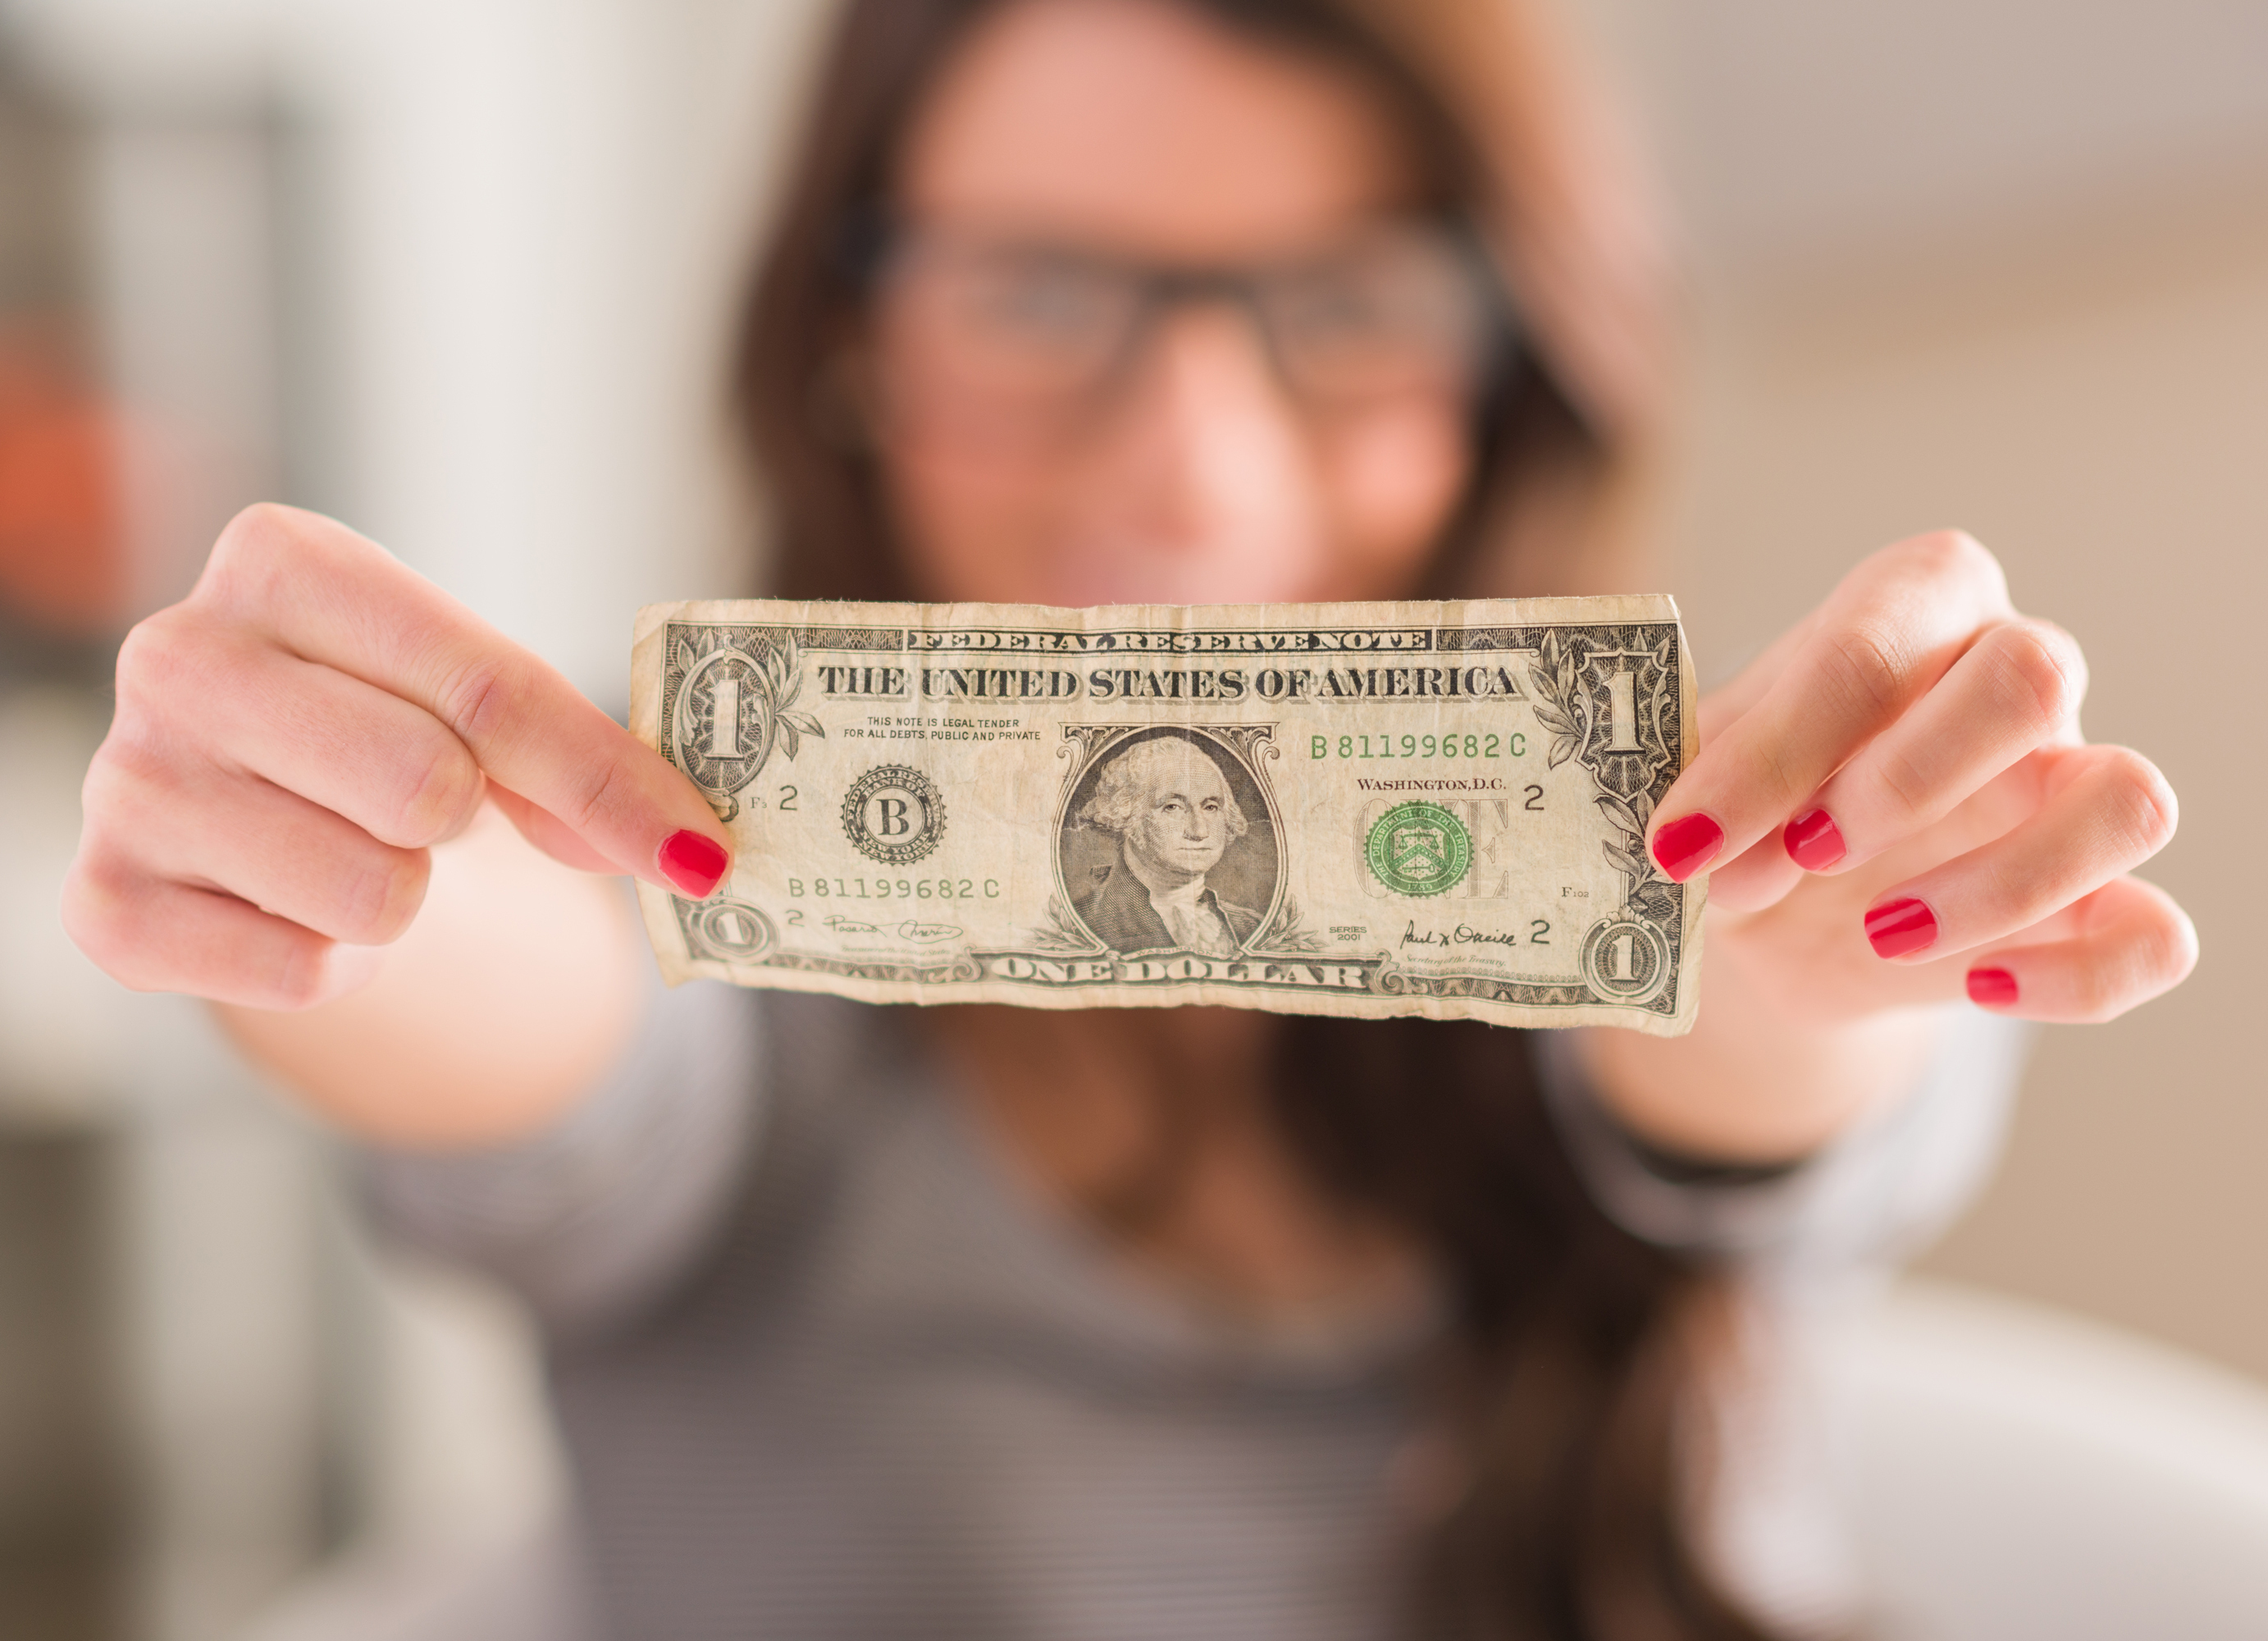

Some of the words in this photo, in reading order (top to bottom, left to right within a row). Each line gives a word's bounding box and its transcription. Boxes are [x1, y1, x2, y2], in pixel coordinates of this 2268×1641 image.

[914, 633, 1107, 651] FEDERAL
[1113, 633, 1309, 651] RESERVE
[1312, 632, 1426, 650] NOTE
[819, 667, 908, 699] THE
[920, 668, 1081, 702] UNITED
[1088, 669, 1246, 702] STATES
[1254, 668, 1312, 701] OF
[1316, 666, 1521, 700] AMERICA
[705, 679, 745, 761] 1
[867, 716, 892, 726] THIS
[897, 717, 923, 727] NOTE
[927, 718, 938, 727] IS
[942, 719, 974, 728] LEGAL
[978, 719, 1020, 728] TENDER
[1602, 671, 1645, 757] 1
[844, 729, 864, 738] FOR
[868, 729, 887, 738] ALL
[931, 731, 970, 741] PUBLIC
[972, 732, 995, 741] AND
[999, 731, 1041, 740] PRIVATE
[779, 784, 797, 811] 2
[1524, 784, 1545, 811] 2
[876, 798, 910, 835] B
[717, 912, 746, 945] 1
[786, 909, 805, 928] 2
[1329, 926, 1367, 934] SERIES
[1531, 920, 1550, 944] 2
[1136, 946, 1213, 956] WASHINGTON
[1610, 934, 1636, 981] 1
[992, 957, 1111, 983] ONE
[1121, 958, 1368, 988] DOLLAR
